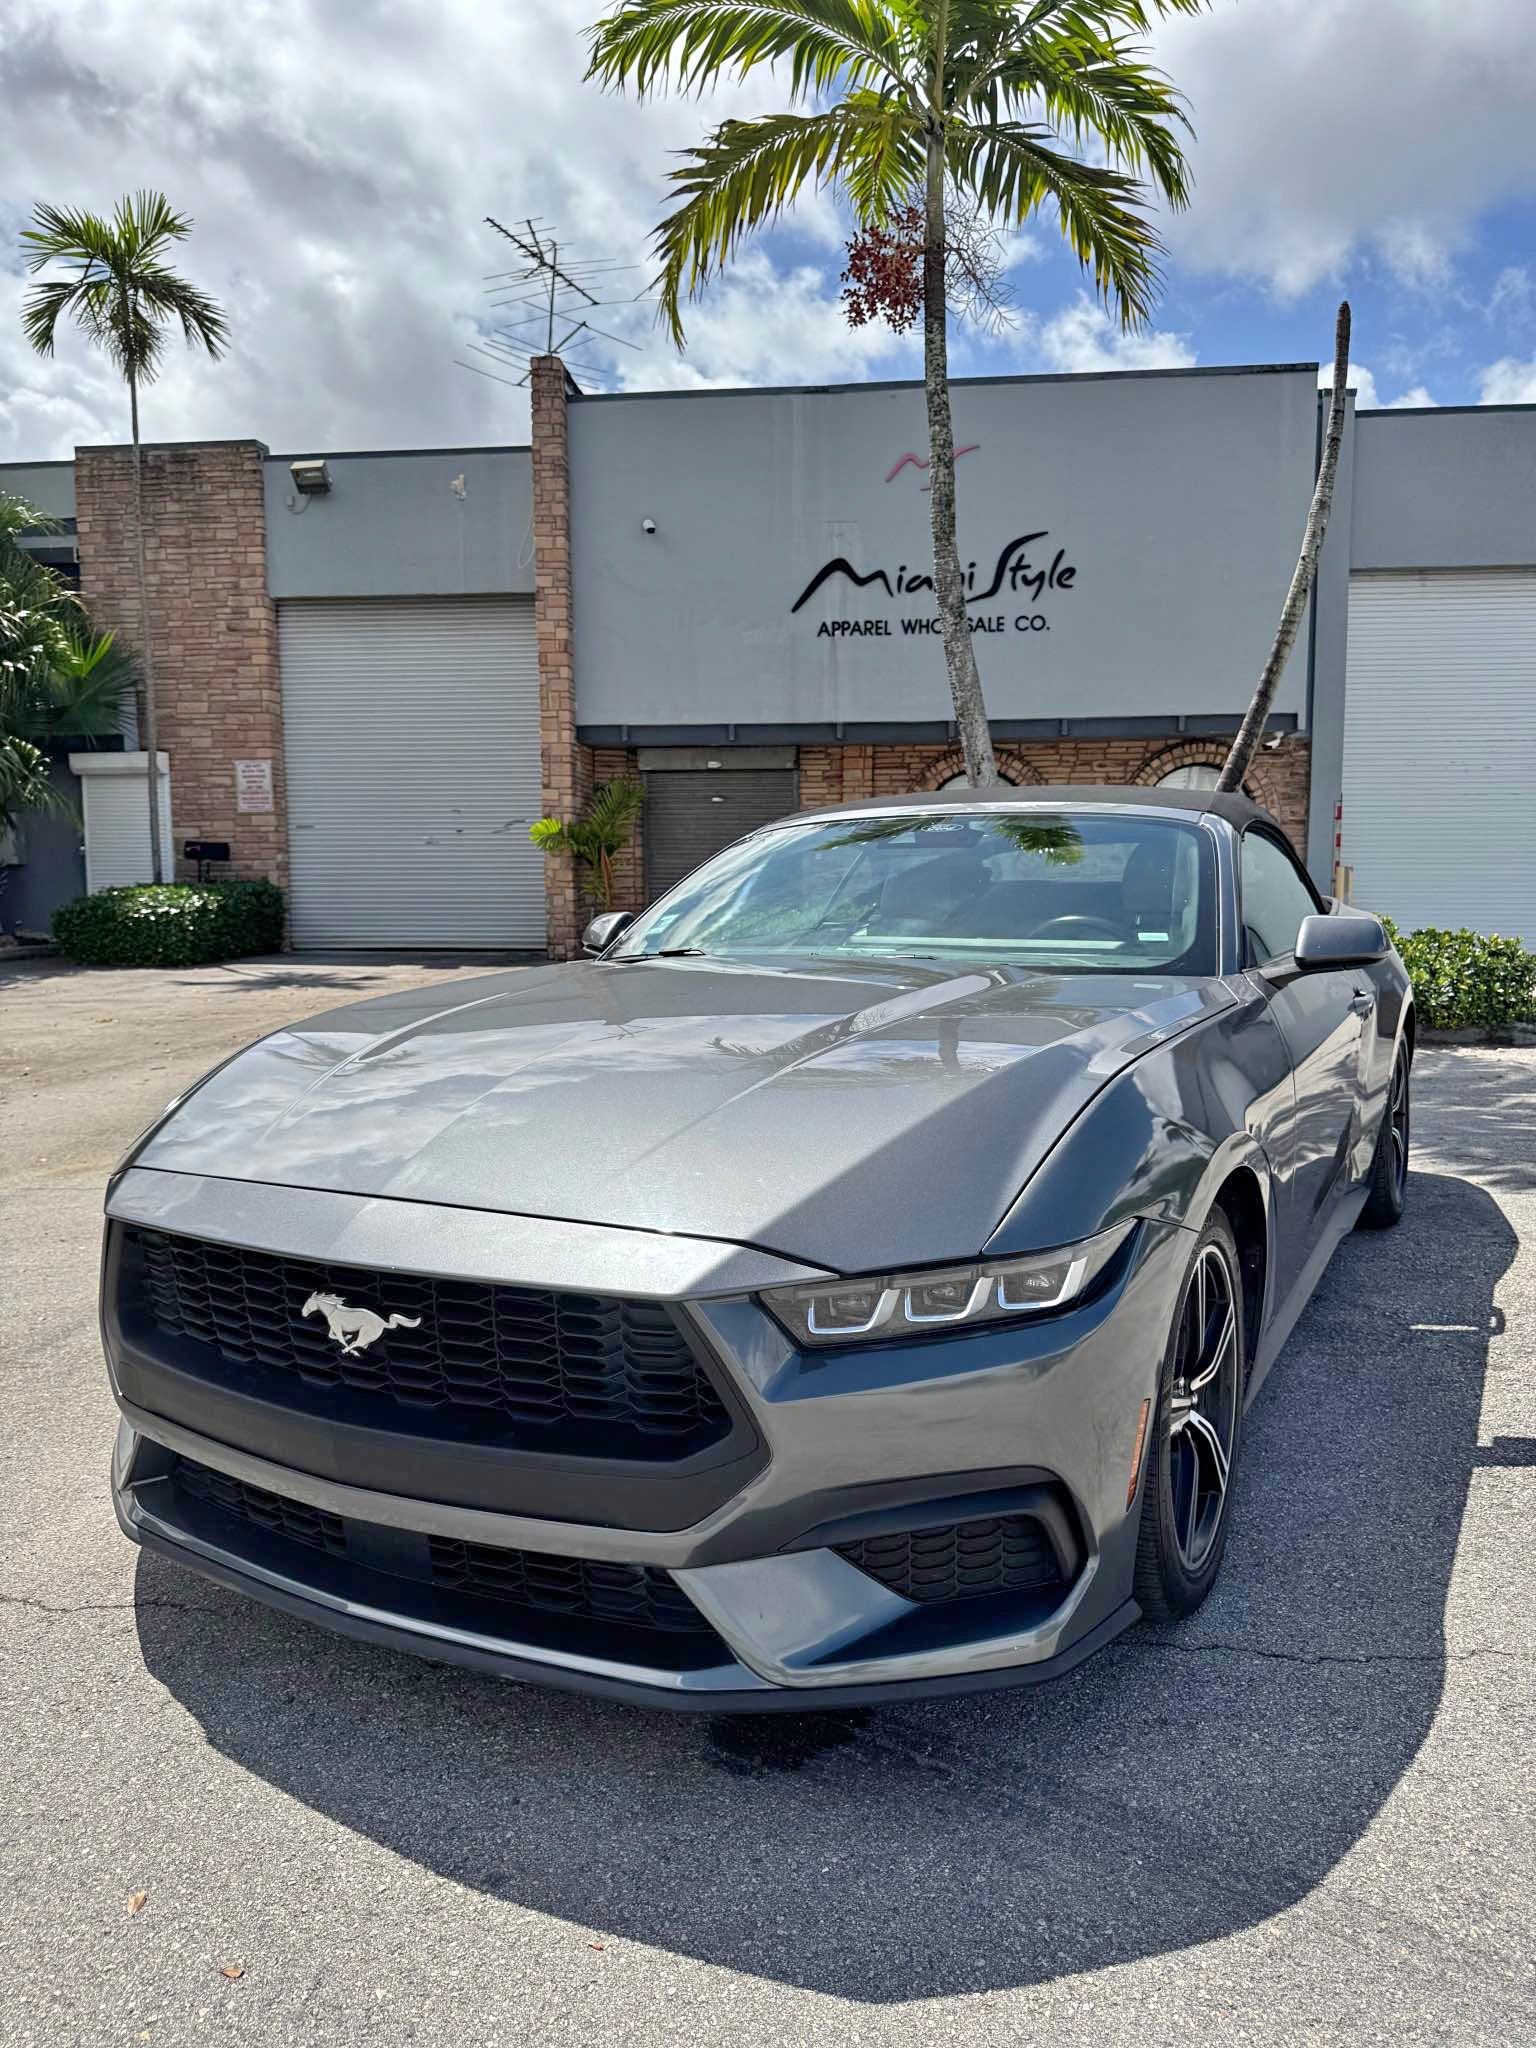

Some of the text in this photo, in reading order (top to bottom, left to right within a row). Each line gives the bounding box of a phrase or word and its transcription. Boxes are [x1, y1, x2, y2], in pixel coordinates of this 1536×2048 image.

[791, 531, 1077, 613] Miai Style
[817, 615, 1051, 637] APPAREL WHOSALE CO.
